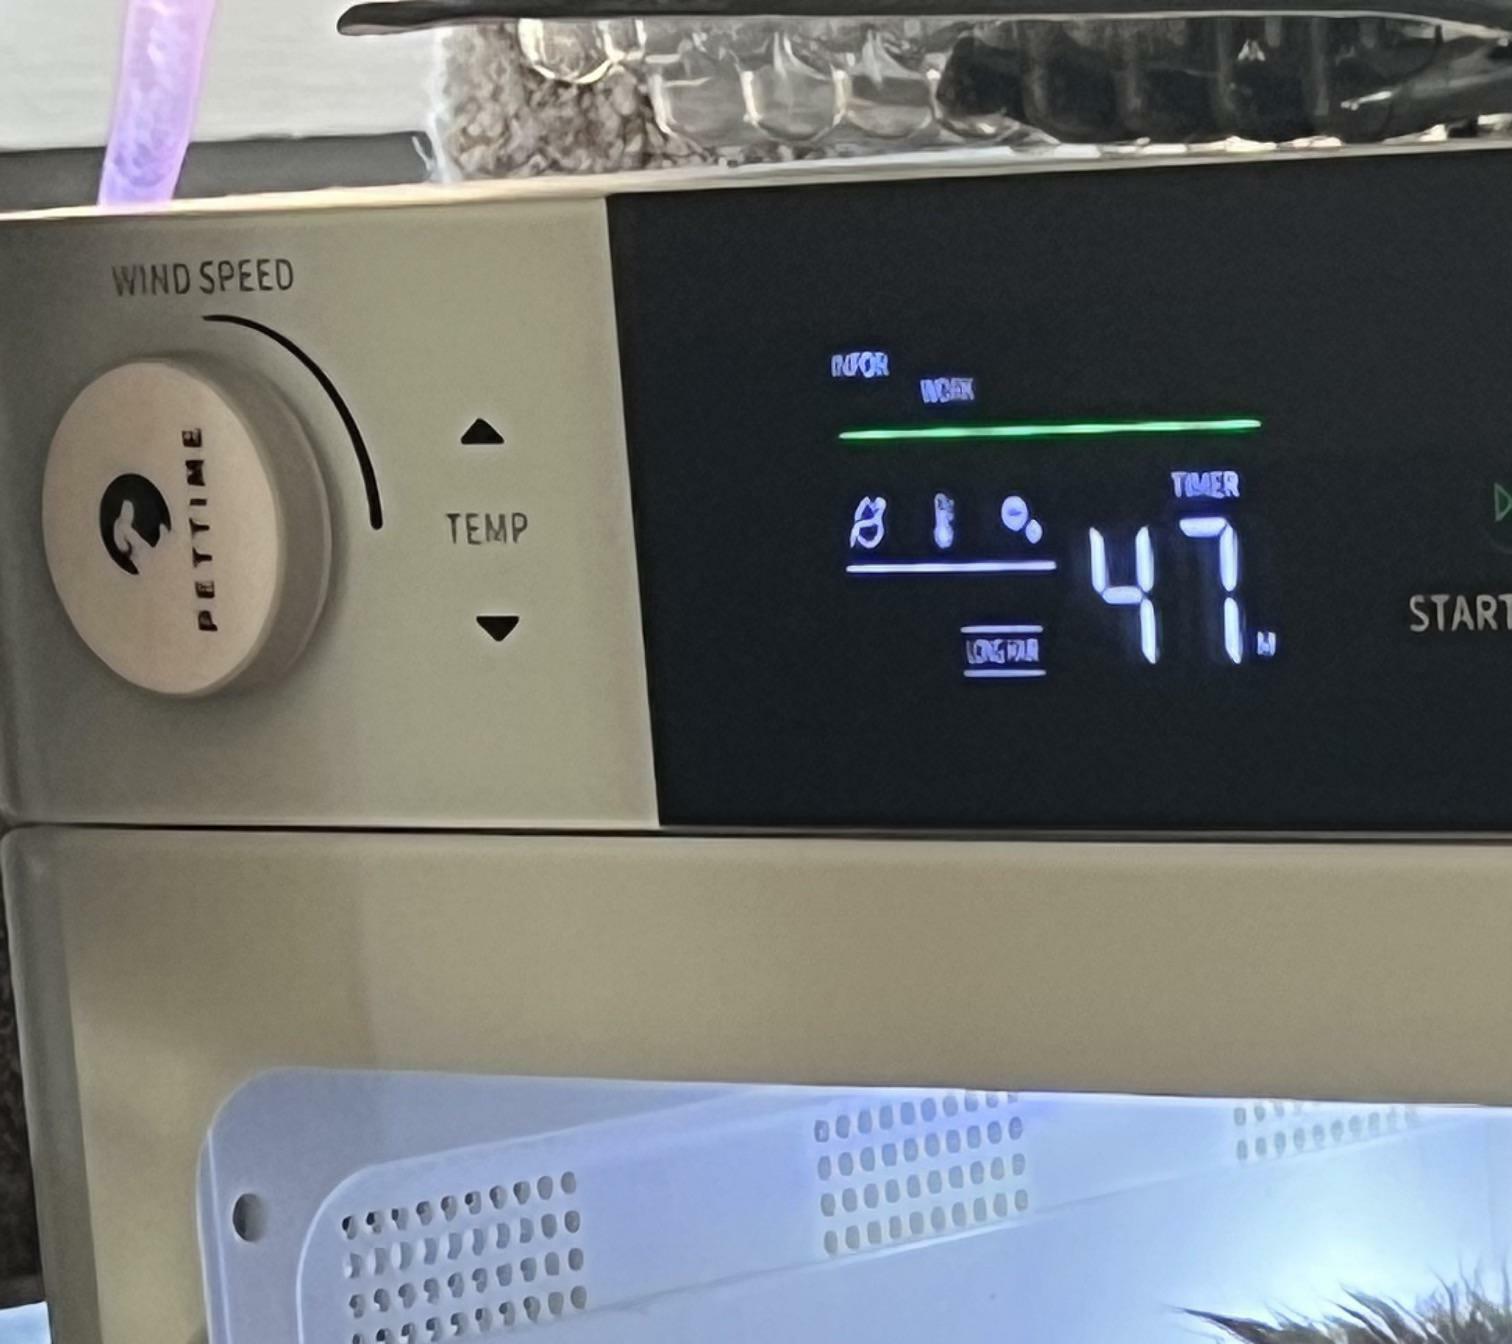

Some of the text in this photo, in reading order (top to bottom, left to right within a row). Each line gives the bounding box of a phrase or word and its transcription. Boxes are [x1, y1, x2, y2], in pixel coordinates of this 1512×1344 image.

[111, 258, 295, 296] WIND SPEED
[1171, 471, 1239, 498] TIMER
[446, 511, 528, 545] TEMP
[1089, 517, 1242, 664] 47
